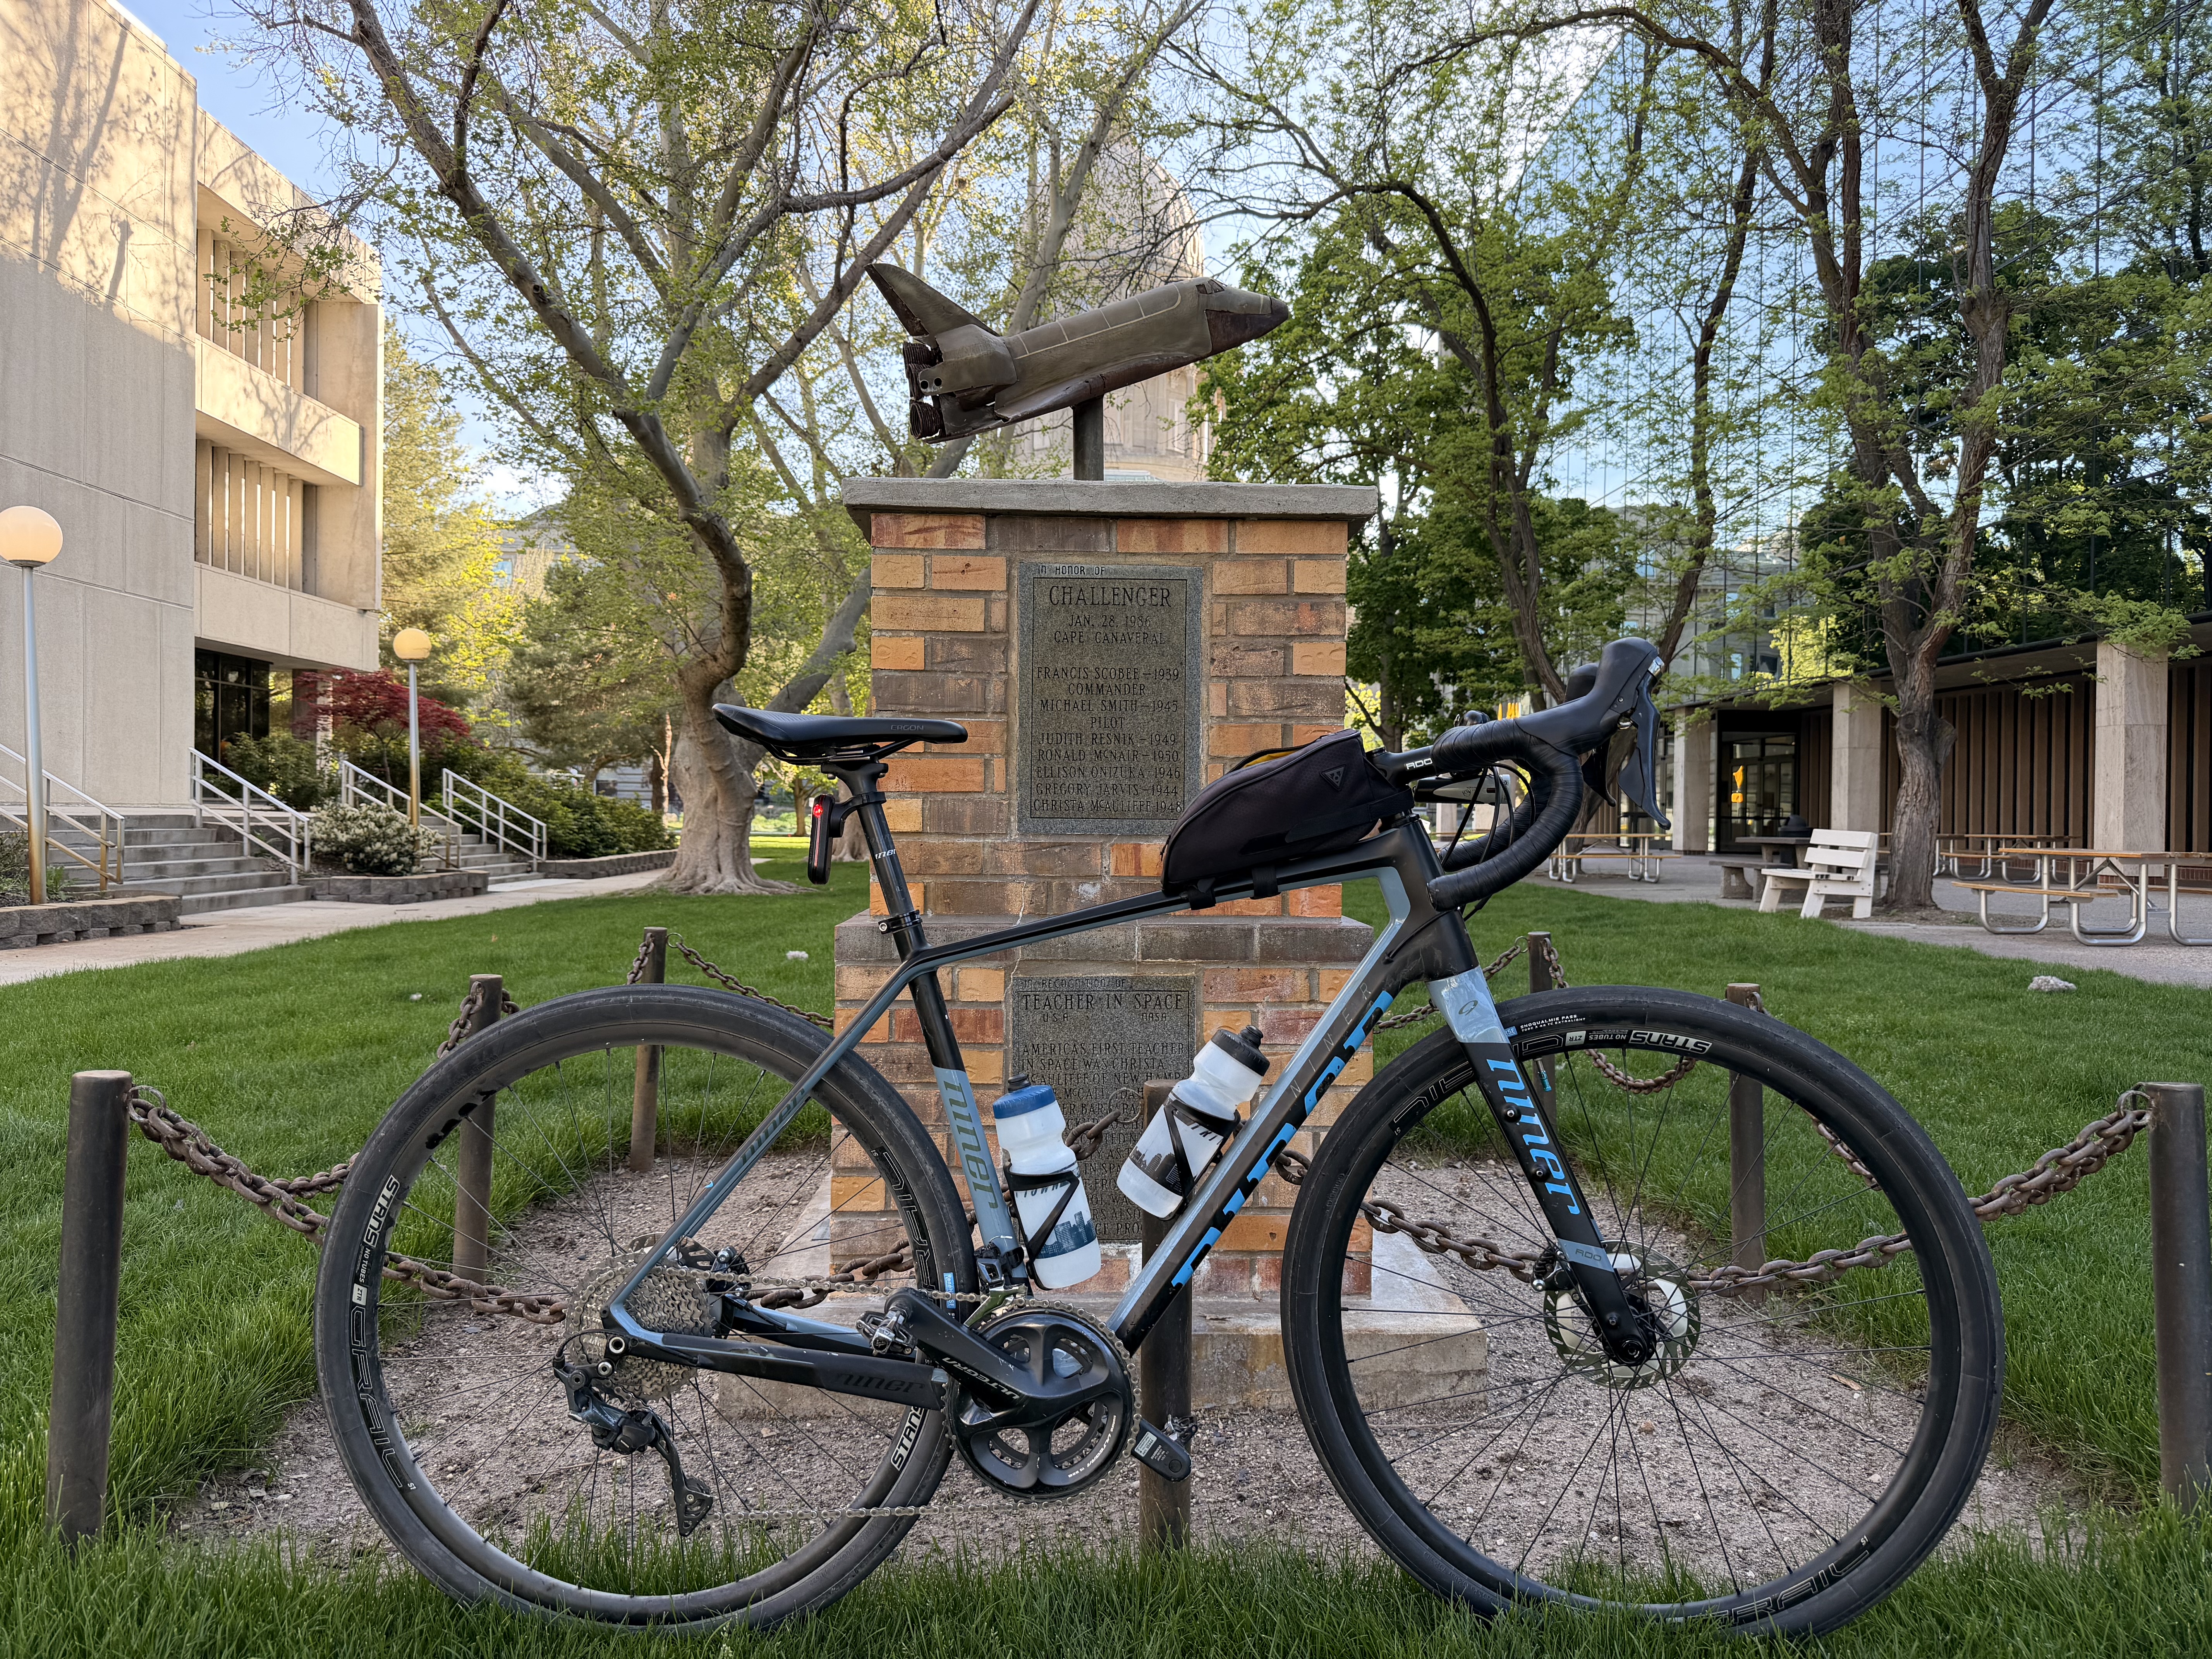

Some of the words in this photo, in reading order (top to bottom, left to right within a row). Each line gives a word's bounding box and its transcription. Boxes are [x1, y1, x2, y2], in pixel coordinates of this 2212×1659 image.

[1037, 565, 1046, 574] IN
[1055, 565, 1085, 575] HONOR
[1094, 566, 1105, 575] OF
[1049, 585, 1171, 607] CHALLENGER
[1068, 614, 1094, 627] JAN.
[1125, 615, 1151, 628] 1986
[1054, 631, 1084, 643] CAPE
[1095, 632, 1165, 645] CANAVERAL
[1037, 667, 1089, 679] FRANCIS
[1094, 667, 1139, 680] SCOBEE
[1068, 683, 1146, 696] COMMANDER
[1040, 699, 1094, 711] MICHAEL
[1101, 700, 1138, 712] SMITH
[1091, 716, 1125, 728] PILOT
[1039, 733, 1082, 745] JUDITH
[1091, 733, 1135, 745] RESNIK
[1038, 749, 1085, 761] RONALD
[1406, 758, 1433, 770] RDO
[1037, 766, 1085, 778] ELLISON
[1091, 766, 1145, 778] ONIZUKA
[1036, 783, 1091, 795] GREGORY
[1097, 784, 1139, 795] JARVIS
[1033, 799, 1084, 812] CHRISTA
[1024, 979, 1032, 988] IN
[1042, 979, 1106, 988] RECOGNITION
[1116, 979, 1126, 988] OF
[1022, 994, 1095, 1010] TEACHER
[1106, 994, 1123, 1009] IN
[1134, 994, 1183, 1010] SPACE
[1142, 1013, 1167, 1022] NASA
[1520, 1017, 1560, 1029] SNOQUALMIE
[1023, 1042, 1085, 1055] AMERICA'S
[1092, 1043, 1123, 1055] FIRST
[1130, 1042, 1184, 1055] TEACHER
[1630, 1032, 1709, 1053] STANS
[1022, 1058, 1033, 1071] IN
[1041, 1058, 1078, 1070] SPACE
[1084, 1058, 1107, 1070] WAS
[1113, 1058, 1164, 1070] CHRISTA
[1093, 1073, 1108, 1085] OF
[1114, 1073, 1140, 1085] NEW
[739, 1087, 805, 1162] niner
[1486, 1058, 1580, 1215] niner
[944, 1080, 998, 1209] niner
[1101, 1163, 1121, 1175] SPA
[1095, 1179, 1116, 1190] FRO
[365, 1177, 398, 1246] STANS
[1111, 1208, 1141, 1220] ALSO
[364, 1248, 371, 1260] NO
[1575, 1248, 1602, 1262] RDO
[359, 1261, 368, 1283] TUBES
[839, 1373, 925, 1393] niner
[942, 1357, 1020, 1400] ULTEGRA
[351, 1305, 403, 1488] GRAIL
[407, 1482, 416, 1490] S1
